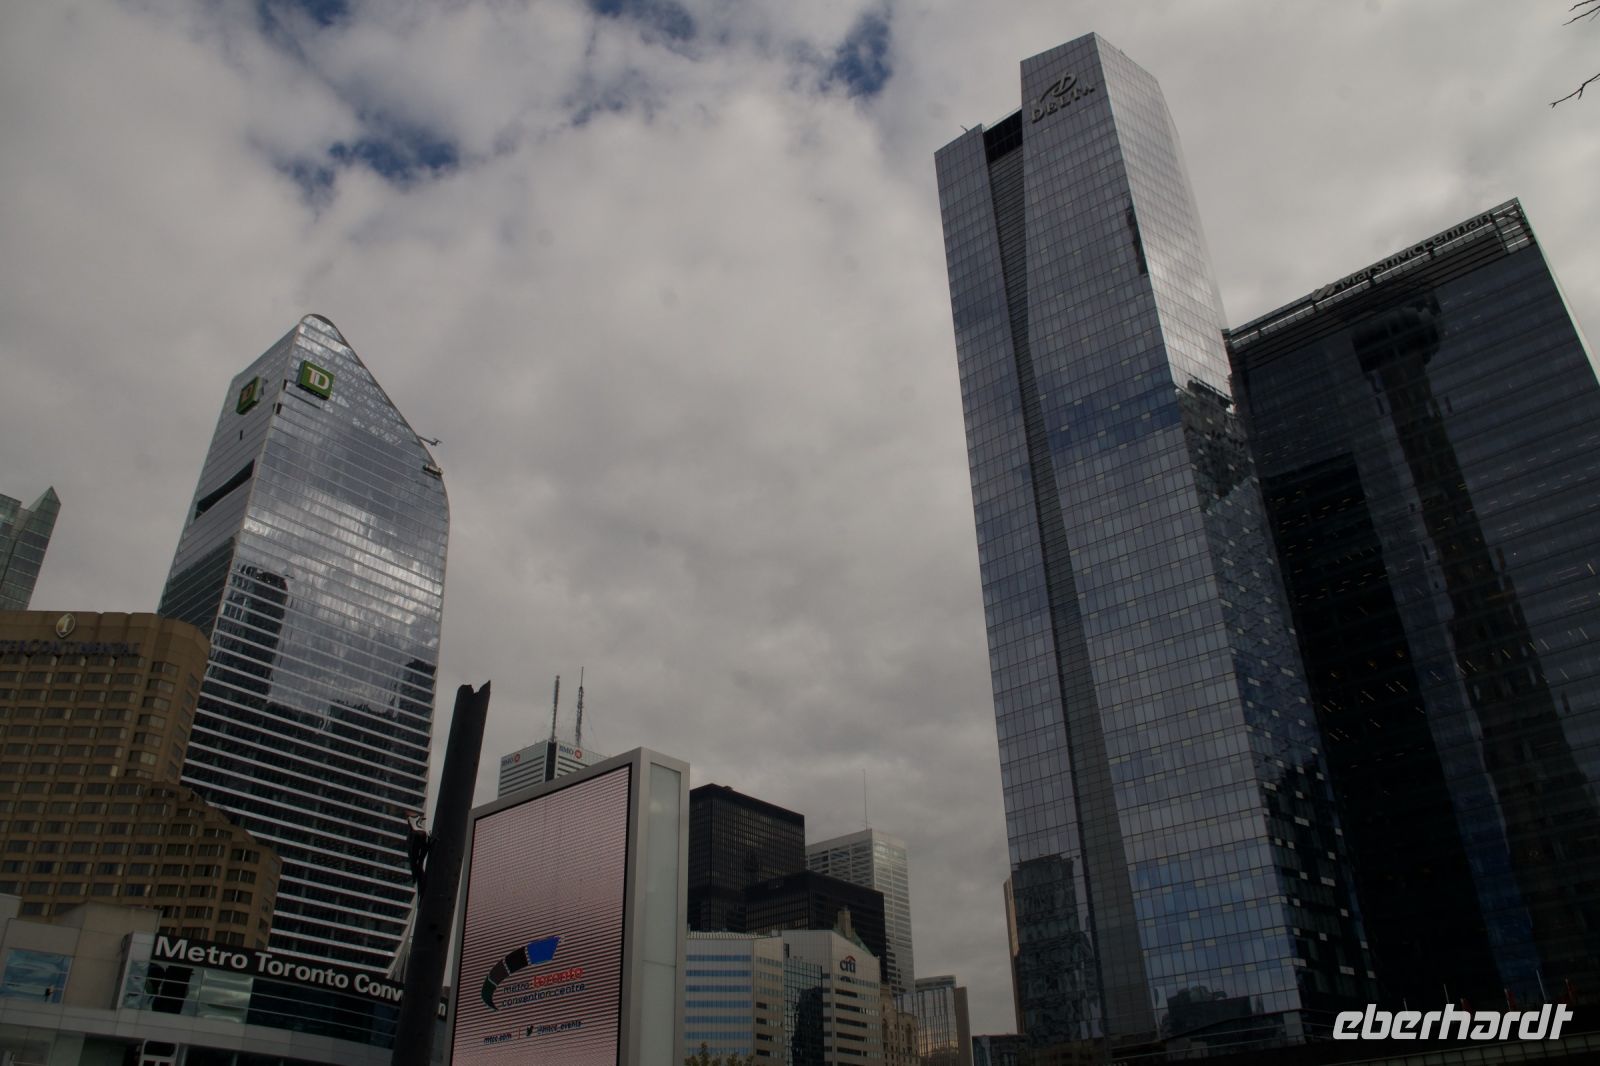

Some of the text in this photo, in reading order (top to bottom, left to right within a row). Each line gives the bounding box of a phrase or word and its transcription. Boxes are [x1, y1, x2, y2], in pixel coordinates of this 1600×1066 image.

[306, 366, 330, 390] TD
[154, 935, 249, 970] Metro
[254, 951, 350, 989] Toronto
